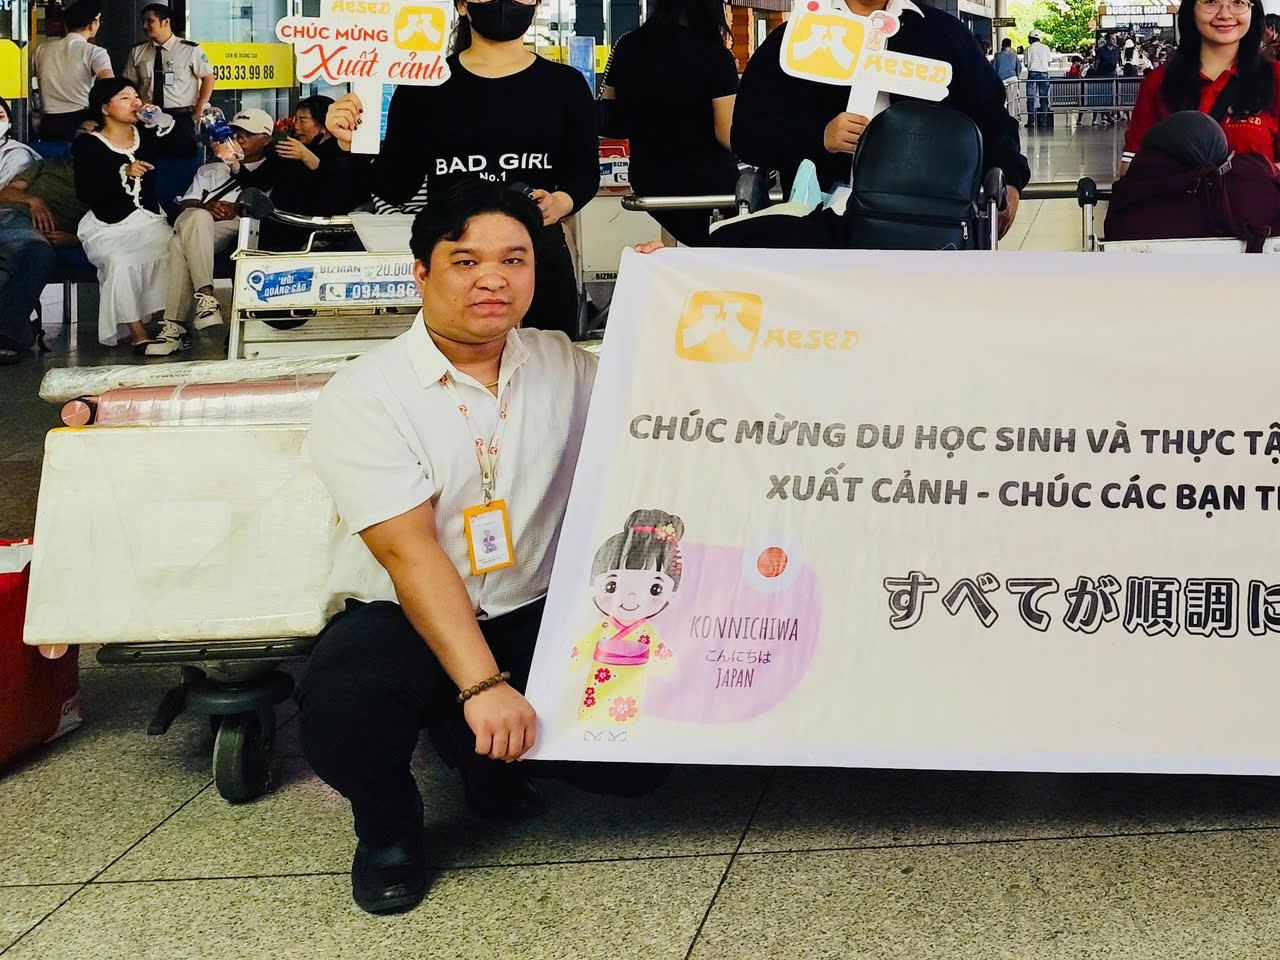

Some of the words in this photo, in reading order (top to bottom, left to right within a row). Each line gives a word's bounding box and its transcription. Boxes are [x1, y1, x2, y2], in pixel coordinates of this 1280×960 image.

[1106, 6, 1143, 15] BURGER
[1144, 5, 1168, 14] KING
[280, 22, 330, 39] CHÚC
[335, 24, 389, 43] MỪNG
[300, 43, 379, 80] Xuất
[388, 51, 446, 80] cảnh
[435, 154, 487, 176] BAD
[499, 152, 552, 170] GIRL
[479, 171, 506, 182] No.1
[320, 265, 361, 274] BIZMAN
[264, 284, 291, 297] QUẢNG
[292, 282, 307, 293] CÁO
[629, 408, 728, 444] CHÚC
[734, 412, 847, 448] MỪNG
[856, 424, 905, 449] DU
[914, 425, 987, 459] HỌC
[994, 426, 1076, 453] SINH
[1086, 420, 1132, 454] VÀ
[1140, 428, 1236, 463] THỰC
[766, 462, 864, 503] XUẤT
[871, 470, 968, 505] CẢNH
[998, 473, 1092, 508] CHÚC
[1100, 474, 1167, 510] CÁC
[1176, 484, 1246, 519] BẠN
[690, 615, 799, 641] KONNICHIWA
[705, 648, 772, 664] こんにちは
[715, 667, 755, 689] JAPAN
